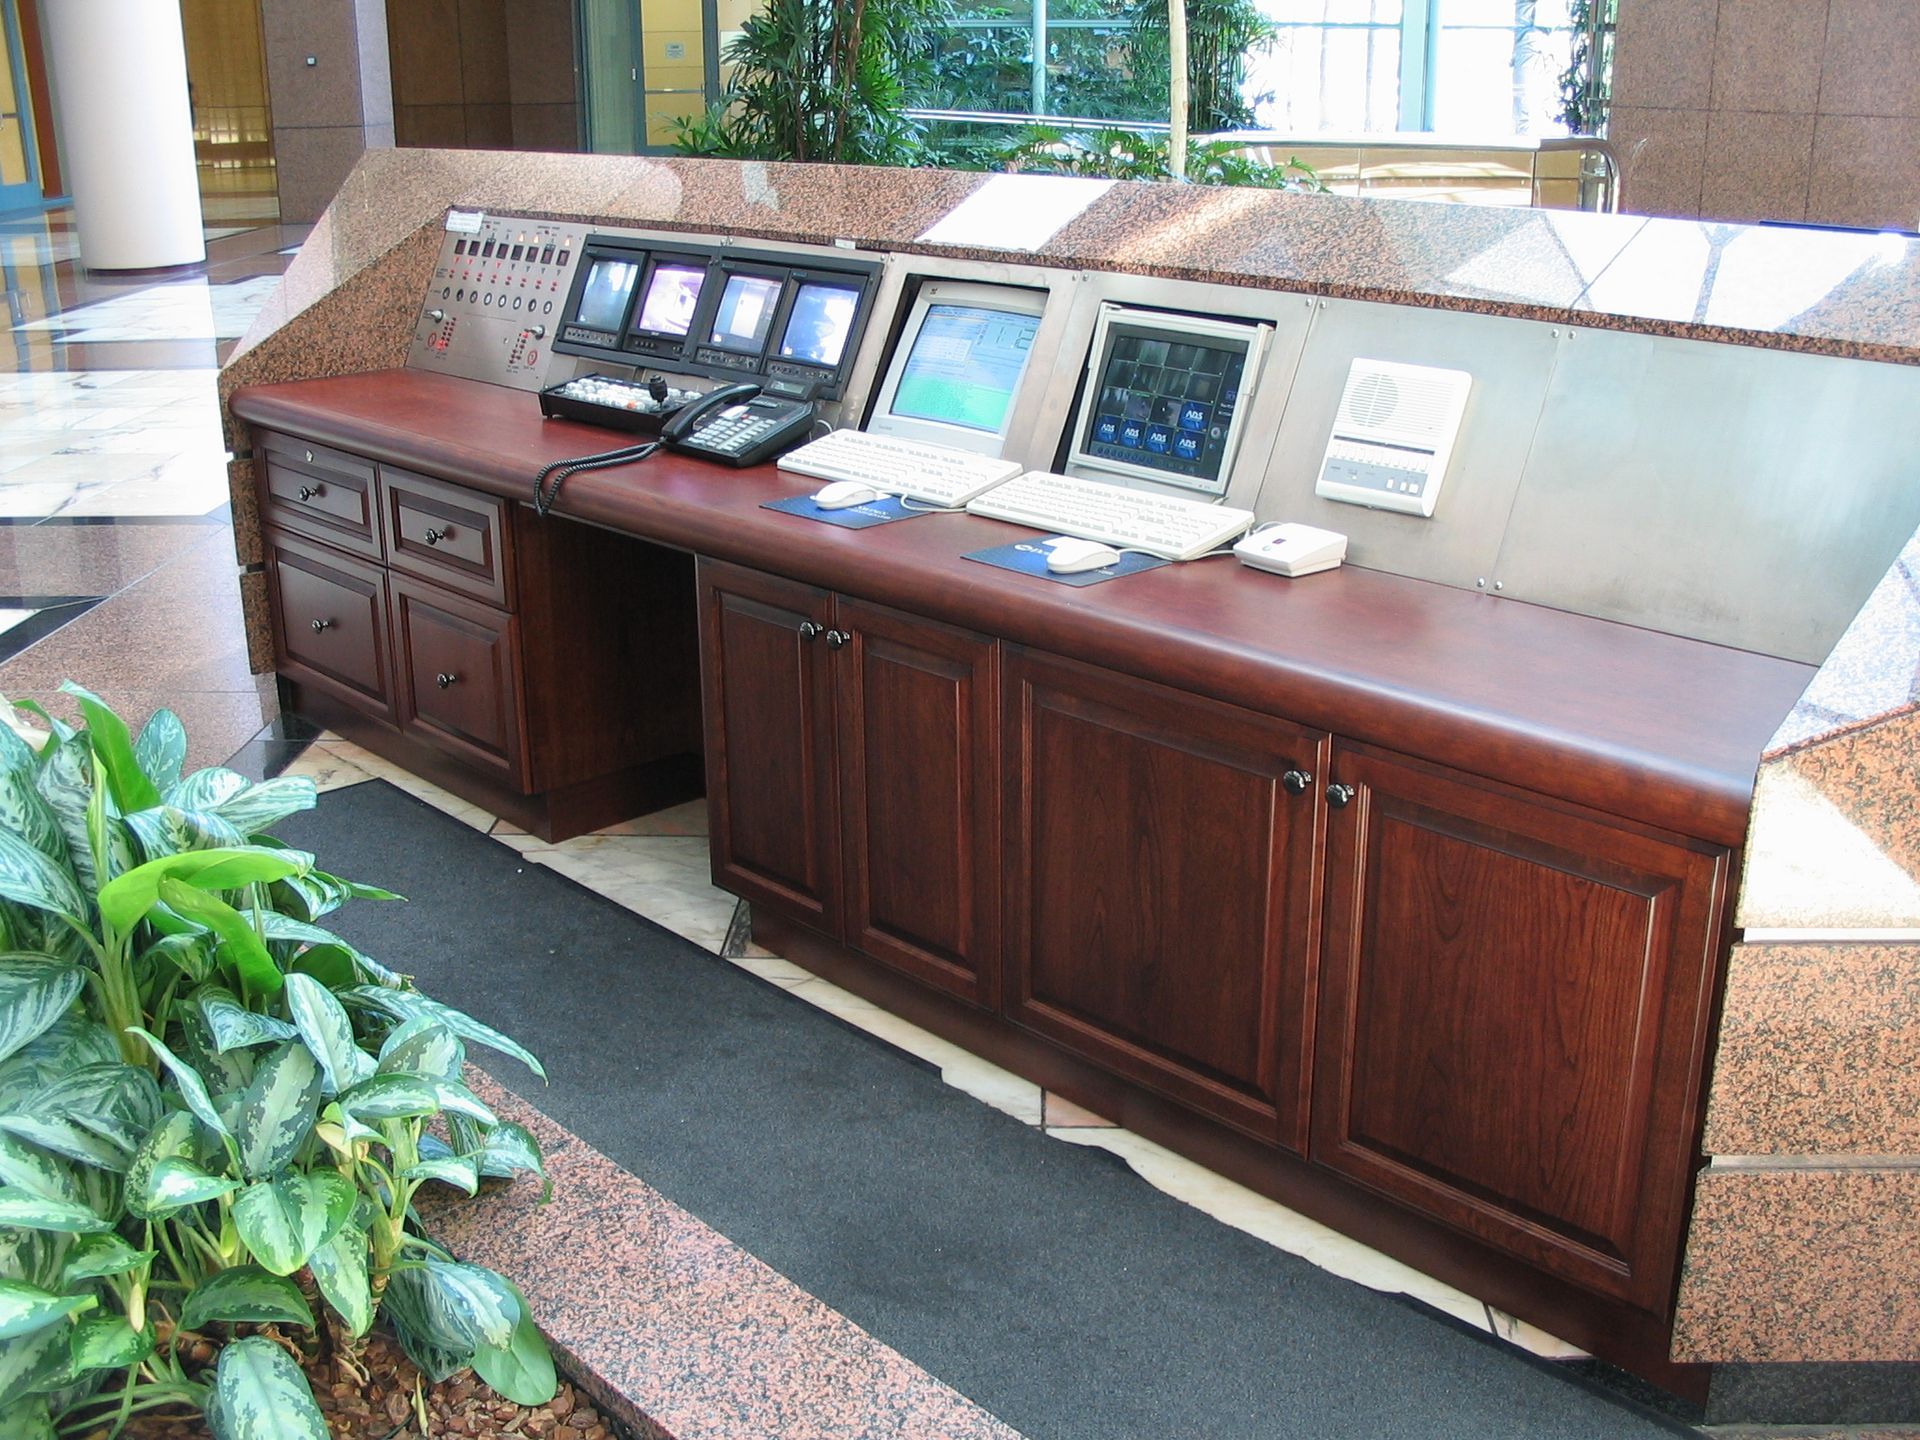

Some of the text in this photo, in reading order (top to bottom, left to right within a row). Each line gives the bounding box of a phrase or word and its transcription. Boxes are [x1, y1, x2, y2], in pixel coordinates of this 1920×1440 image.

[1186, 410, 1204, 420] ADS
[1100, 424, 1114, 432] ADS
[1124, 428, 1139, 437] ADS
[1150, 433, 1166, 442] ADS
[1179, 439, 1196, 448] ADS
